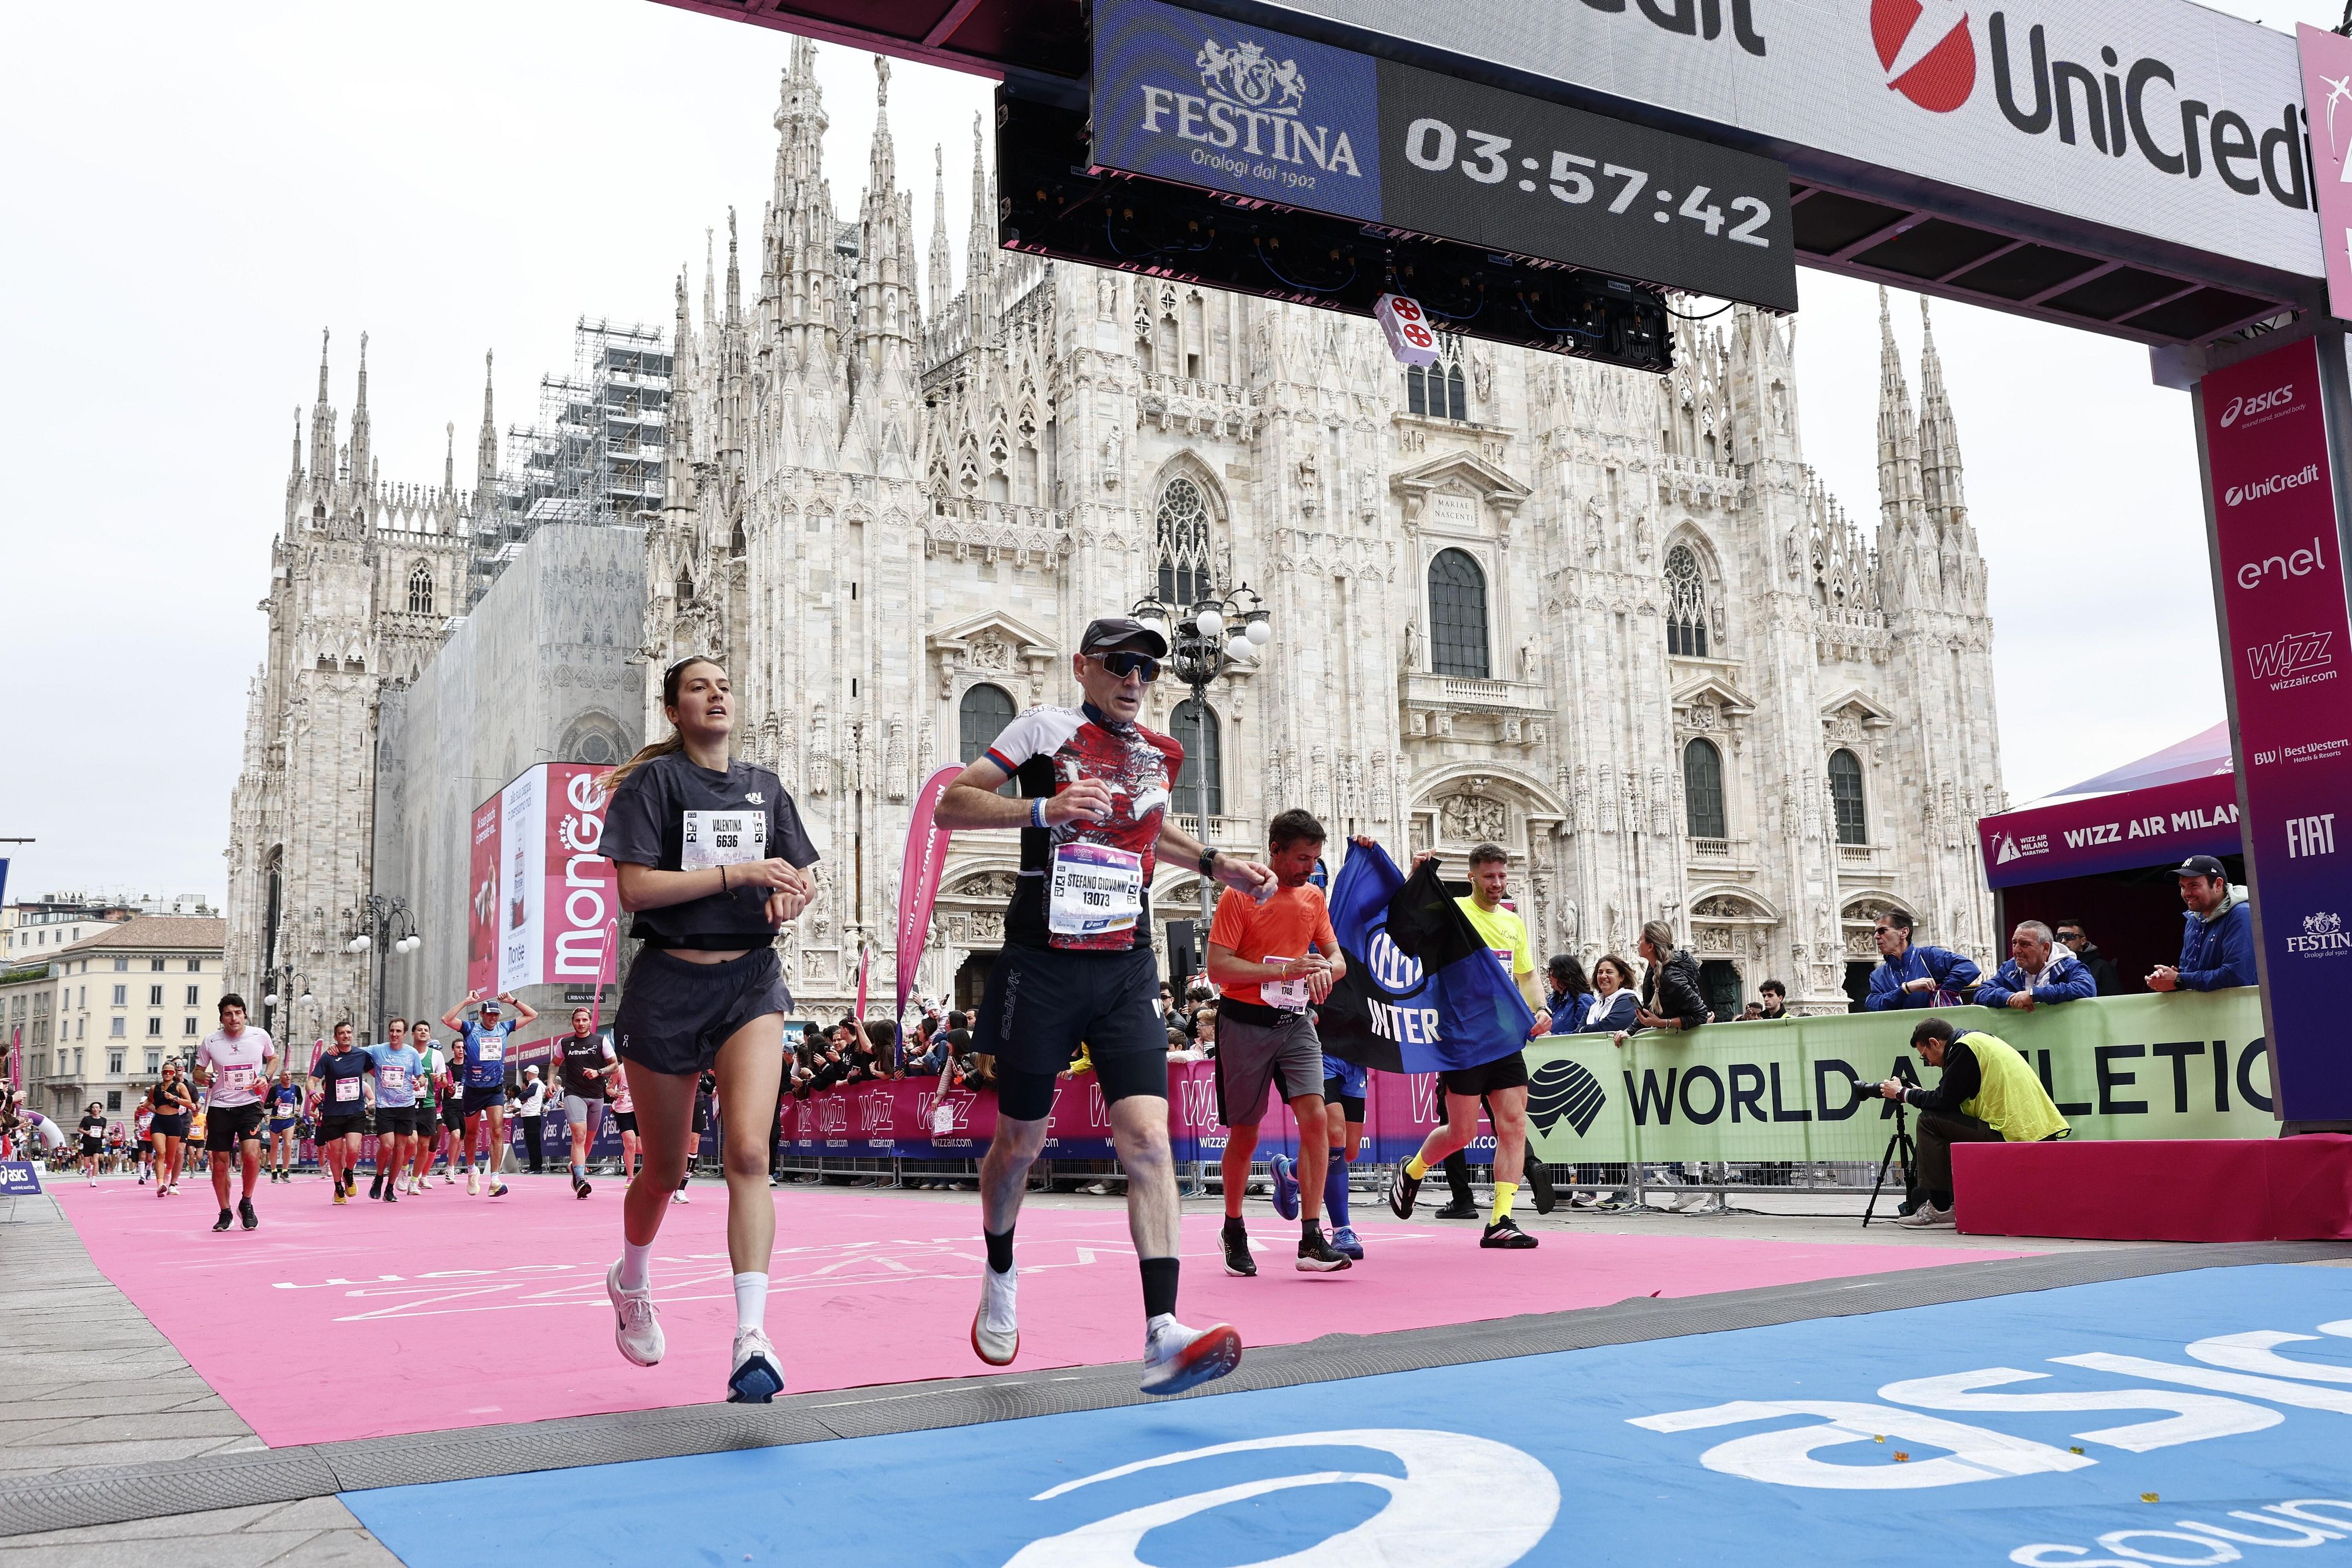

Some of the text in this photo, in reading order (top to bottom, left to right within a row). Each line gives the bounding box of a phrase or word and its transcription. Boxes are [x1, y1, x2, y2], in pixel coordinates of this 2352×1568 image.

[1989, 11, 2319, 213] UniCredi
[1141, 85, 1362, 177] FESTINA
[1191, 148, 1317, 189] Orologi dal 1902
[1405, 117, 1772, 248] 03:57:42
[2244, 384, 2293, 416] asics
[2241, 403, 2306, 429] sound mind, sound body
[2244, 463, 2318, 500] UniCredit
[1438, 499, 1469, 510] MARIAE
[1435, 510, 1474, 521] NASCENTI
[2238, 537, 2325, 589] enel
[2270, 670, 2337, 691] wizzair.com
[2284, 737, 2349, 757] Best Western
[2293, 755, 2313, 763] Hotels
[2319, 749, 2341, 758] Resorts
[2254, 750, 2276, 765] BW
[713, 819, 741, 832] VALENTINA
[923, 784, 946, 872] MARATON
[2063, 823, 2122, 848] WIZZ
[2128, 816, 2166, 839] AIR
[2286, 813, 2334, 858] FIAT
[716, 835, 738, 847] 6636
[2020, 835, 2035, 844] WIZZ
[2021, 841, 2048, 851] MILANO
[1068, 874, 1128, 893] STEFANO GIOVANNI
[1083, 891, 1110, 907] 13073
[2286, 932, 2352, 952] FESTIN
[1281, 987, 1292, 995] 1748
[1001, 969, 1021, 1041] KARPOS
[1367, 998, 1444, 1044] INTER
[1623, 1059, 1860, 1126] WORLD
[858, 1089, 894, 1135] WIZZ
[917, 1089, 977, 1129] WZZ
[548, 1124, 557, 1137] asics
[826, 1138, 848, 1148] wizzair.com
[868, 1137, 894, 1148] wizzair.com
[931, 1137, 973, 1148] wizzair.com
[8, 1169, 28, 1182] asics
